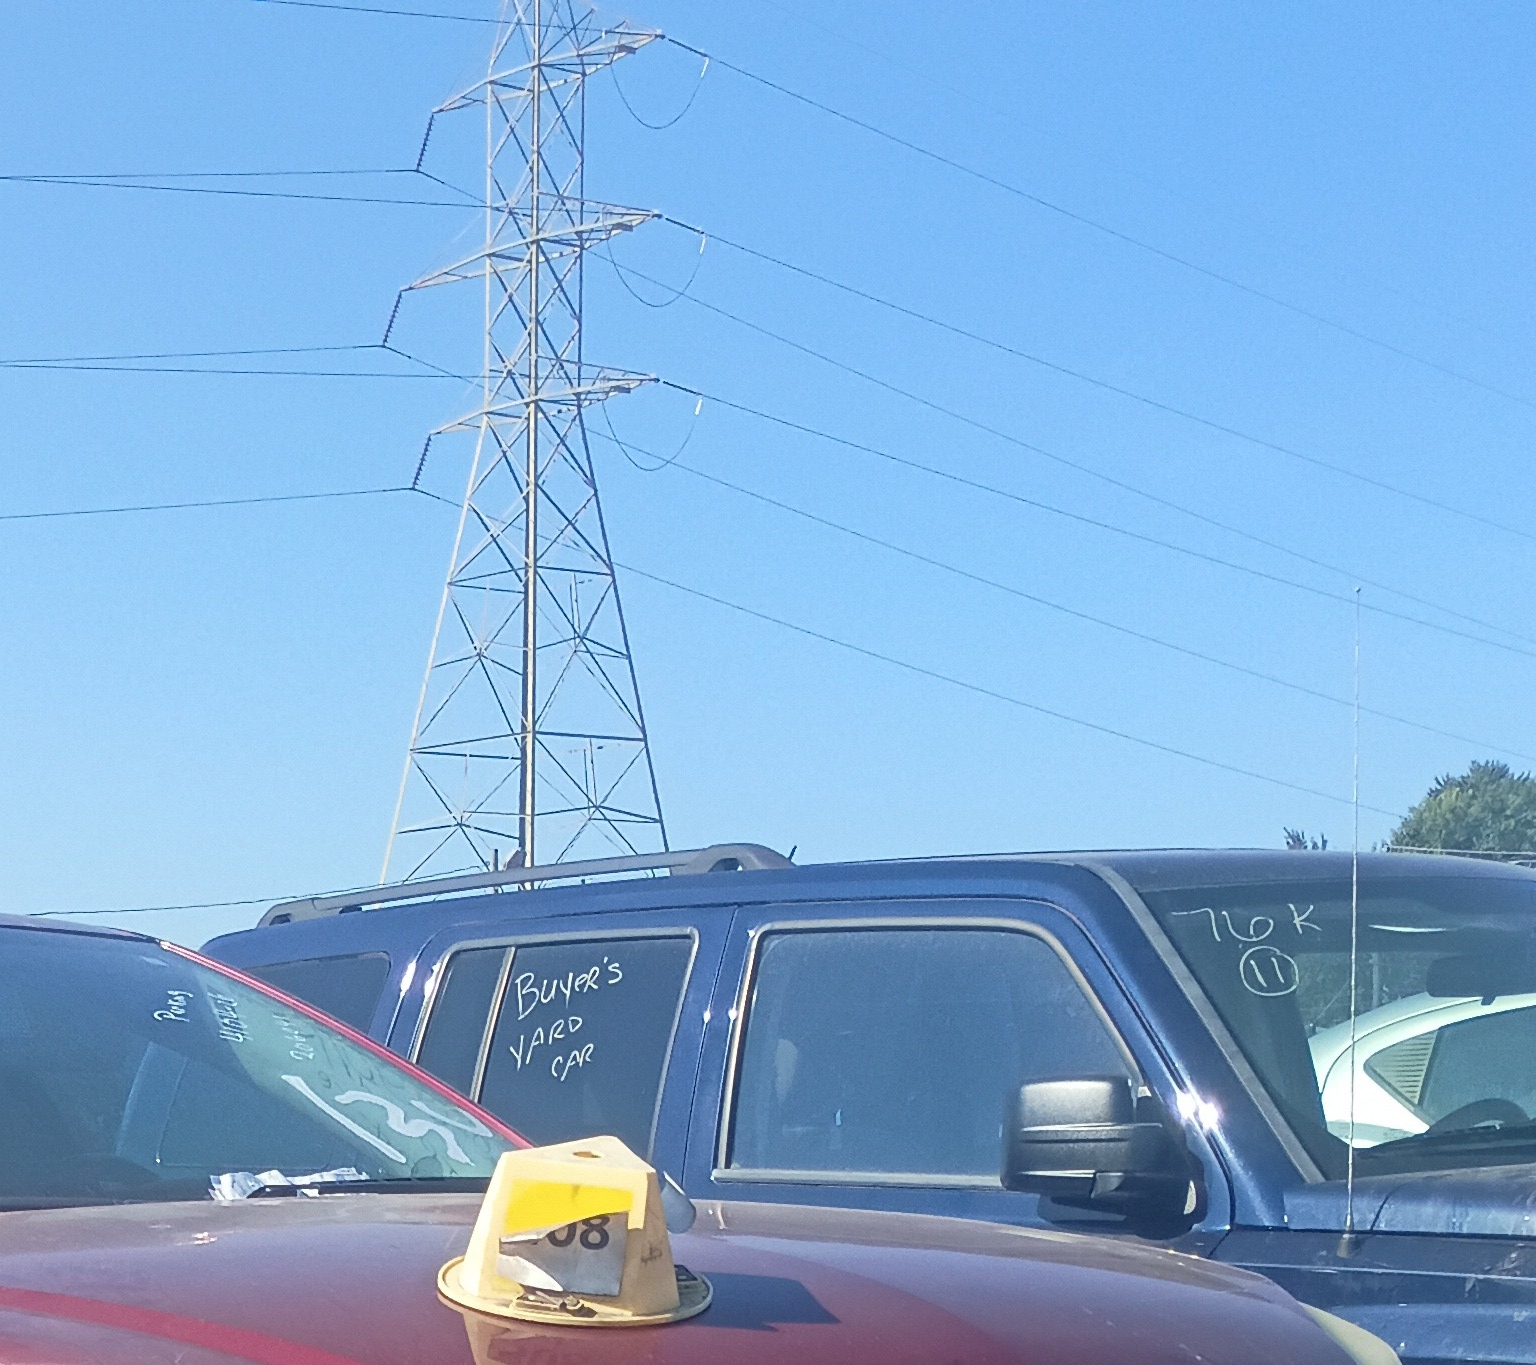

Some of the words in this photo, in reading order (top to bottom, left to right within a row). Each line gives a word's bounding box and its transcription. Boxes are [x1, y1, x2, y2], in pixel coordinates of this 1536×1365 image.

[1170, 907, 1275, 943] 76
[1286, 902, 1323, 935] K
[1249, 956, 1286, 988] 11
[508, 1015, 584, 1072] YARD
[550, 1042, 595, 1082] CAR
